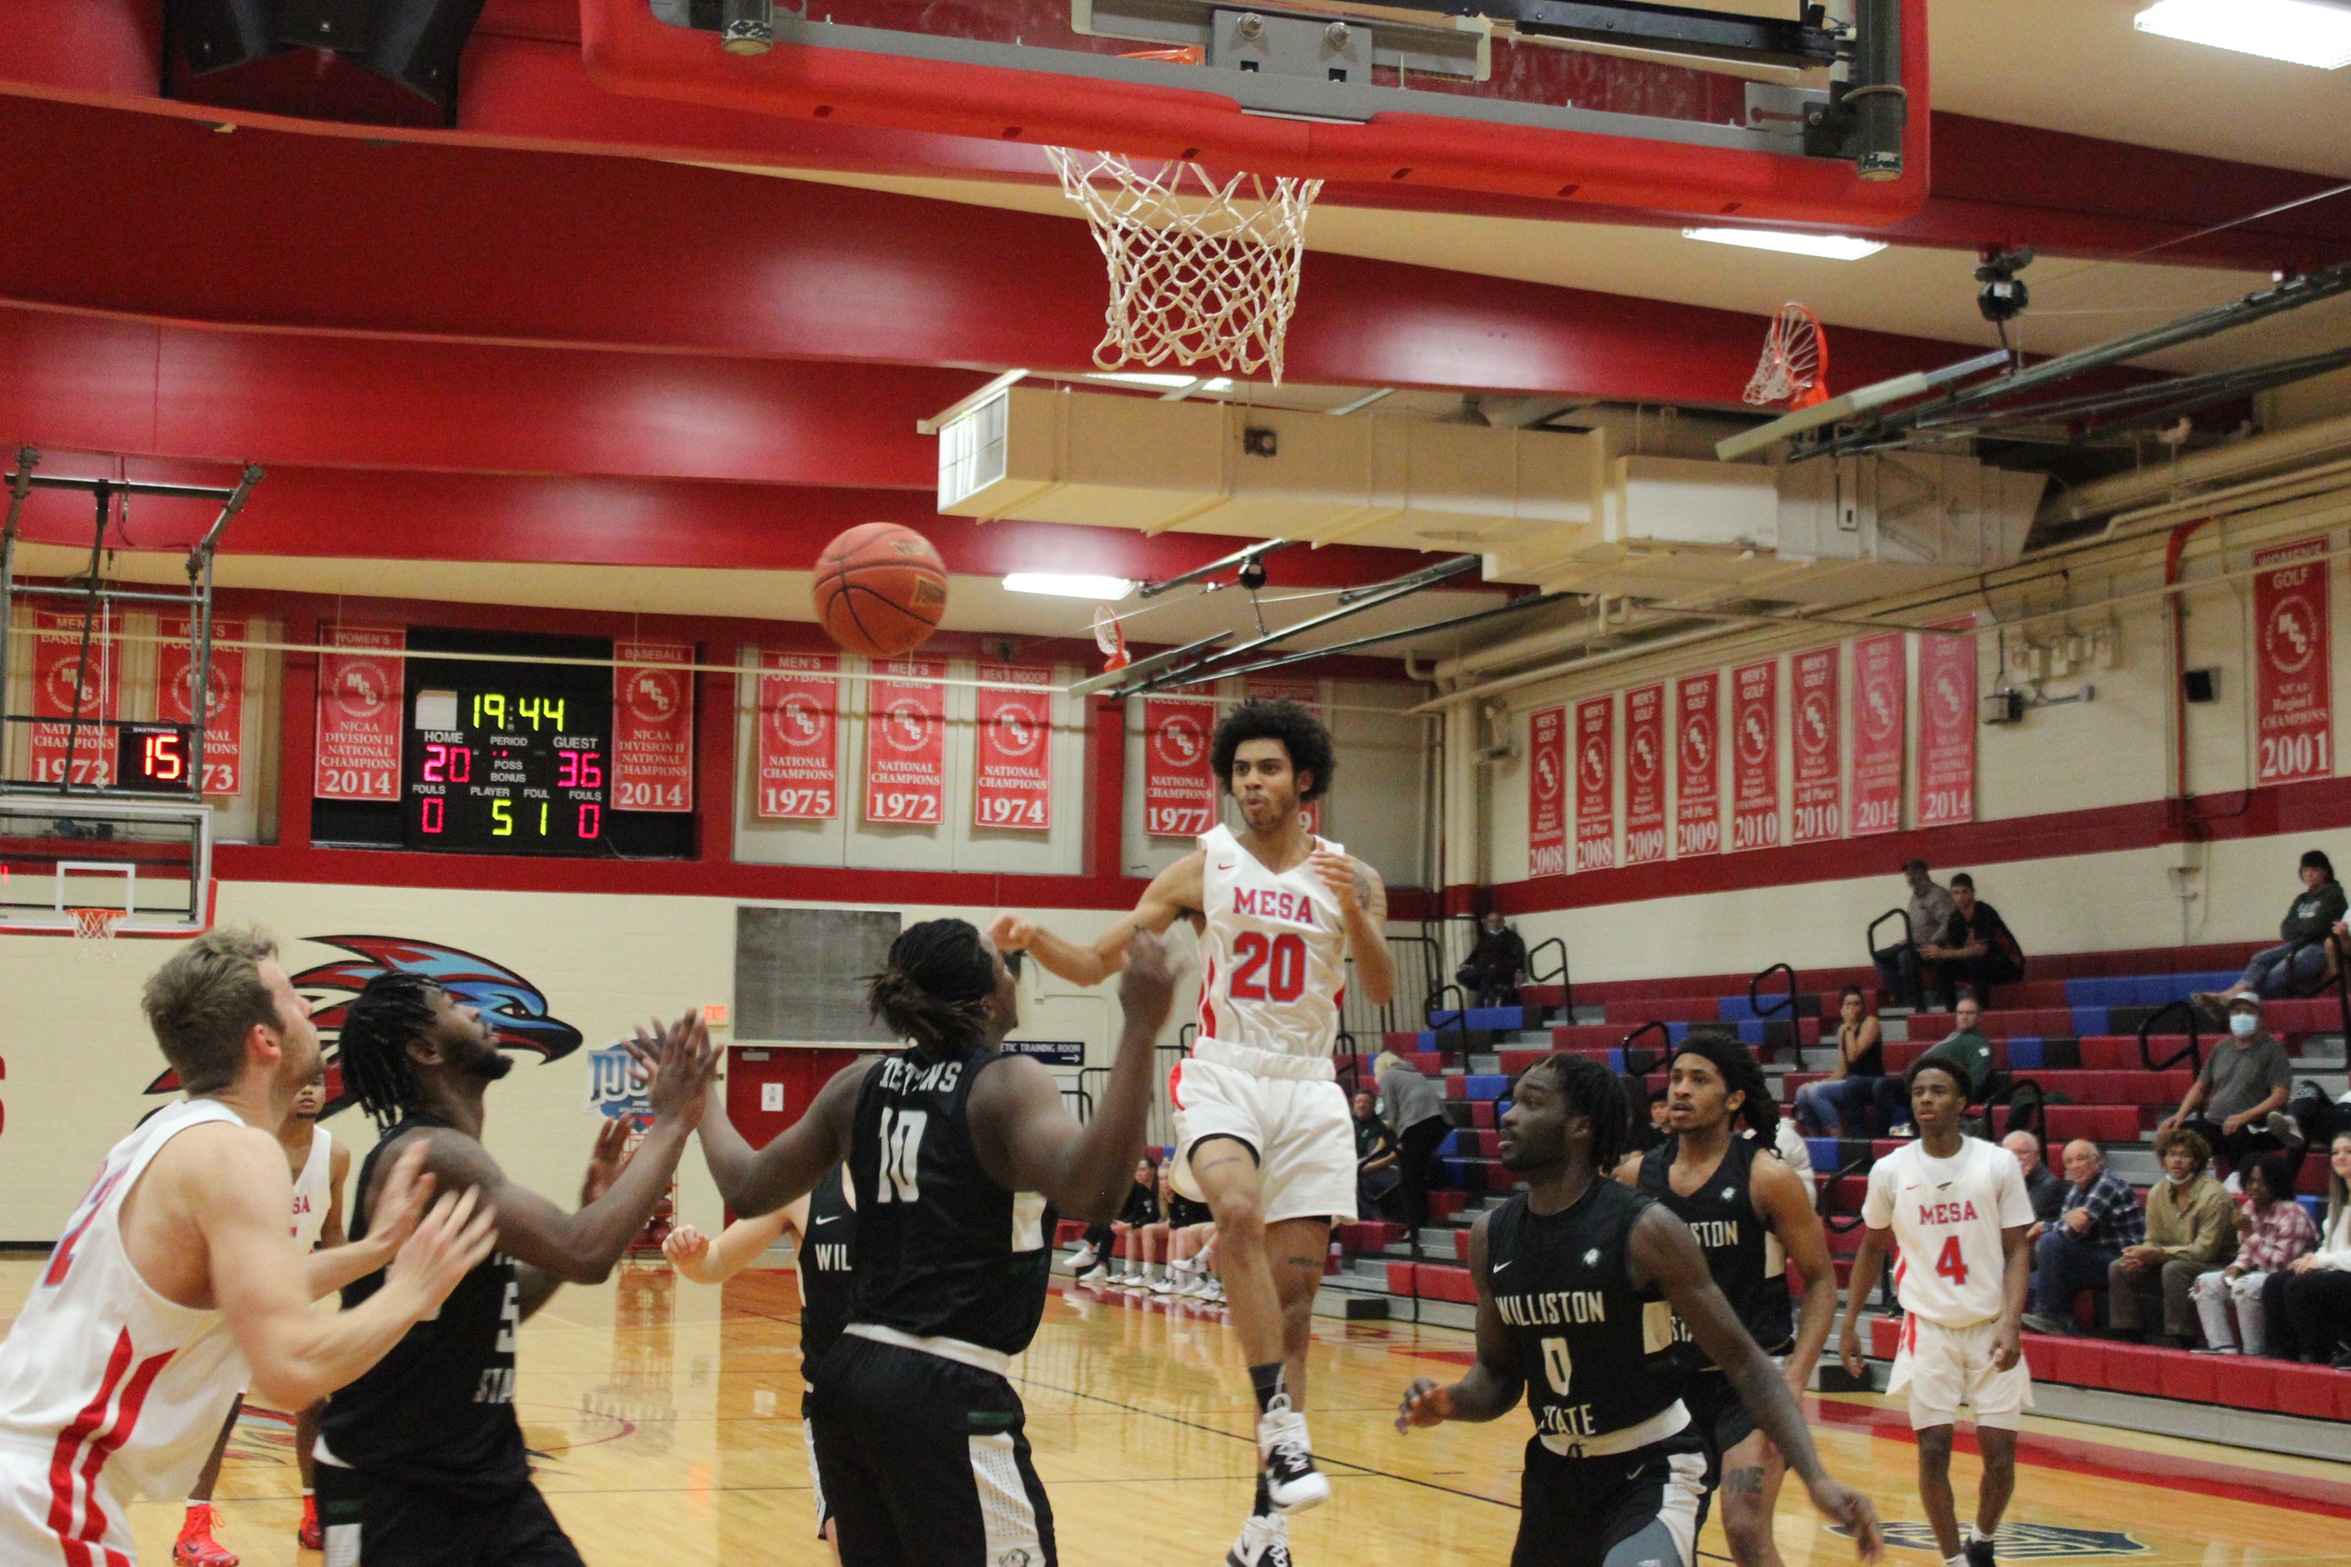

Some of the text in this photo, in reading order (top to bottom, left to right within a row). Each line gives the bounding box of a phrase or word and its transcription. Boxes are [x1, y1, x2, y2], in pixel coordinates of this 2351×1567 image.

[2273, 566, 2309, 589] GOLF
[625, 649, 684, 661] BASEBALL
[778, 656, 821, 670] MEN'S
[888, 663, 929, 675] MEN'S
[340, 721, 379, 732] NJCAA
[424, 731, 464, 744] HOME
[633, 730, 671, 741] NJCAA
[325, 733, 394, 745] DIVISION II
[490, 736, 528, 747] PERIOD
[553, 736, 598, 749] GUEST
[619, 741, 673, 753] DIVISION
[144, 735, 181, 779] 15
[328, 745, 391, 757] NATIONAL
[622, 753, 682, 765] NATIONAL
[769, 756, 828, 768] NATIONAL
[2261, 731, 2330, 778] 2001
[321, 757, 396, 769] CHAMPIONS
[423, 744, 471, 783] 20
[494, 761, 523, 771] POSS
[557, 750, 602, 788] 36
[616, 764, 687, 777] CHAMPIONS
[763, 768, 834, 780] CHAMPIONS
[878, 761, 934, 773] NATIONAL
[984, 766, 1041, 778] NATIONAL
[325, 769, 391, 794] 2014
[490, 772, 526, 783] BONUS
[871, 772, 941, 785] CHAMPIONS
[979, 777, 1047, 790] CHAMPIONS
[1151, 776, 1206, 788] NATIONAL
[412, 785, 446, 795] FOULS
[470, 786, 550, 799] PLAYER FOUL
[569, 790, 602, 801] FOULS
[620, 782, 683, 806] 2014
[766, 788, 832, 814] 1975
[1147, 787, 1212, 799] CHAMPIONS
[421, 797, 444, 833] 0
[873, 792, 937, 819] 1972
[981, 798, 1045, 823] 1974
[1857, 799, 1899, 828] 2014
[1924, 790, 1970, 820] 2014
[492, 799, 513, 836] 5
[578, 803, 601, 839] 0
[1149, 807, 1210, 832] 1977
[1795, 803, 1838, 838] 2010
[1678, 820, 1718, 853] 2009
[1735, 812, 1777, 847] 2010
[1578, 837, 1612, 869] 2008
[1627, 829, 1664, 862] 2009
[1531, 845, 1564, 876] 2008
[1233, 886, 1313, 924] MESA
[1229, 931, 1306, 1003] 20
[1020, 1044, 1055, 1053] TRAINING
[1057, 1044, 1080, 1053] ROOM
[877, 1106, 928, 1204] 10
[1918, 1200, 1978, 1225] MESA
[1936, 1235, 1969, 1286] 4
[1495, 1291, 1606, 1326] WILLISTON
[1541, 1337, 1572, 1397] 0
